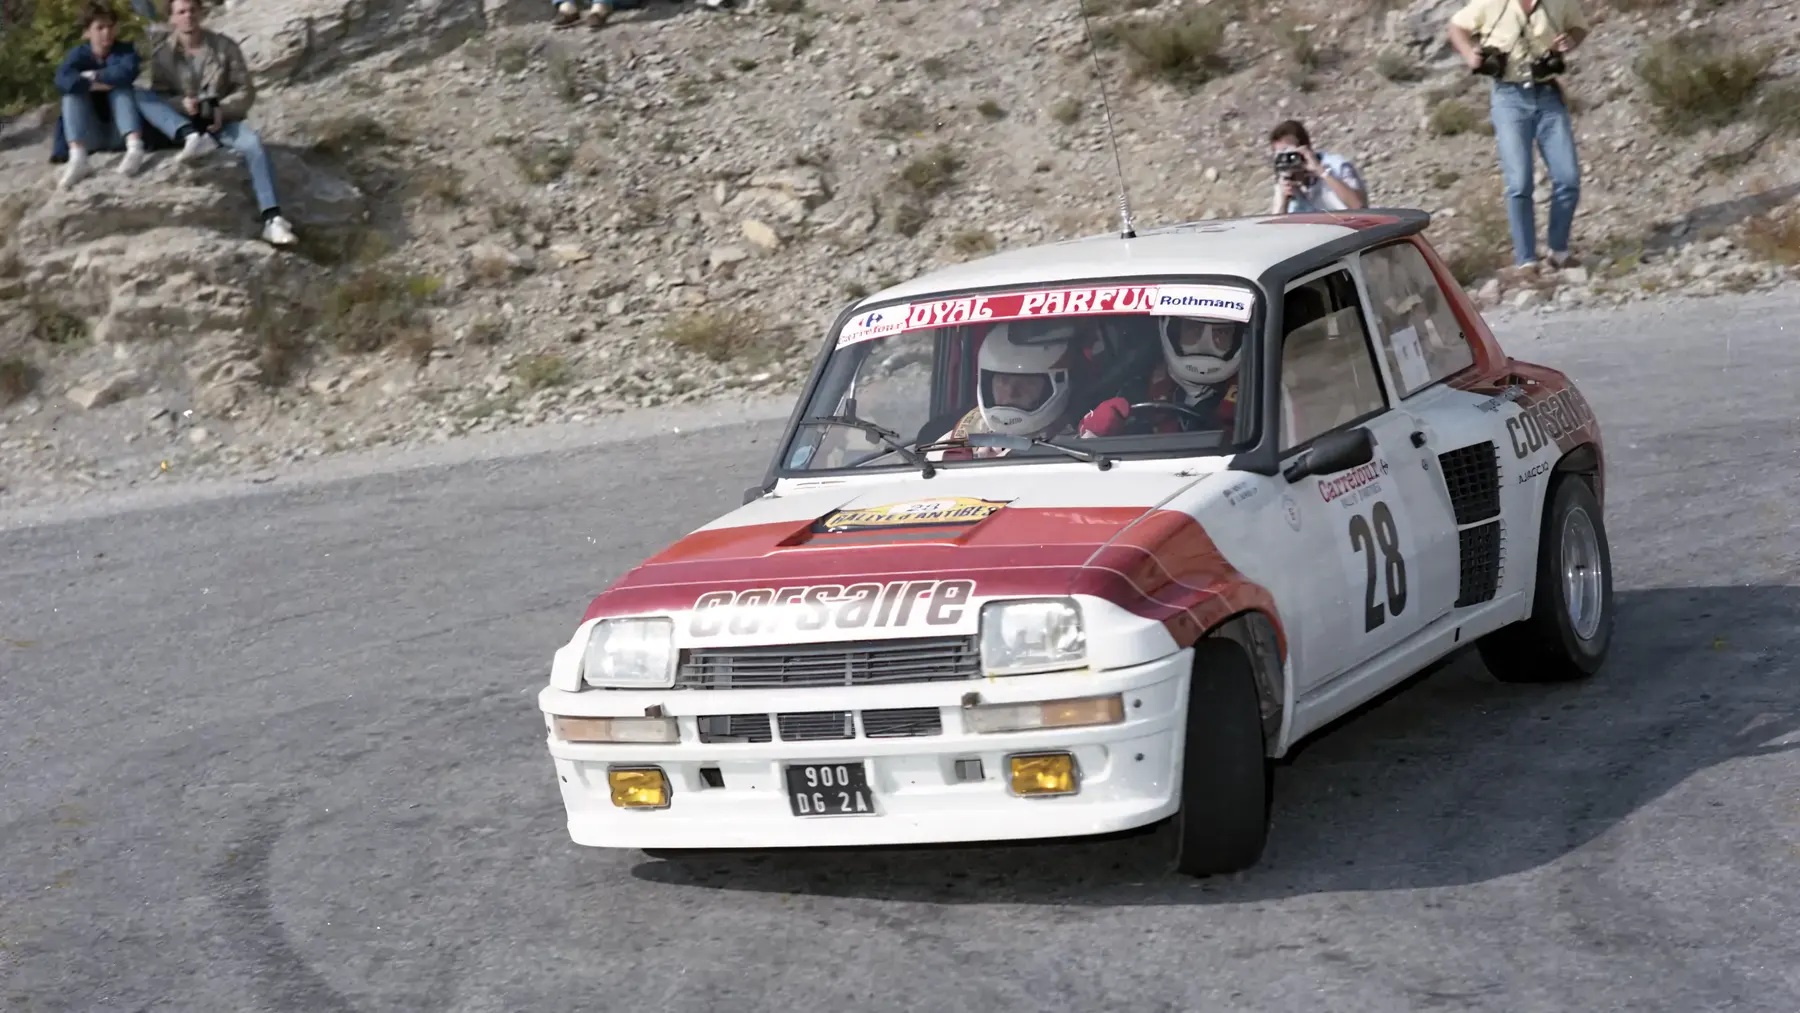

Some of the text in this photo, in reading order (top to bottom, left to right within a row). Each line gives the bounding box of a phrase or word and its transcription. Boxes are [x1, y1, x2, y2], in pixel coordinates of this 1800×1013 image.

[905, 295, 993, 328] OYAL
[1159, 294, 1245, 312] Rothmans
[1318, 461, 1379, 503] Carrefour
[831, 512, 894, 526] RALLYE
[1349, 501, 1407, 634] 28
[688, 578, 977, 638] corsaire
[805, 765, 849, 788] 900
[796, 790, 868, 814] DG 2A
